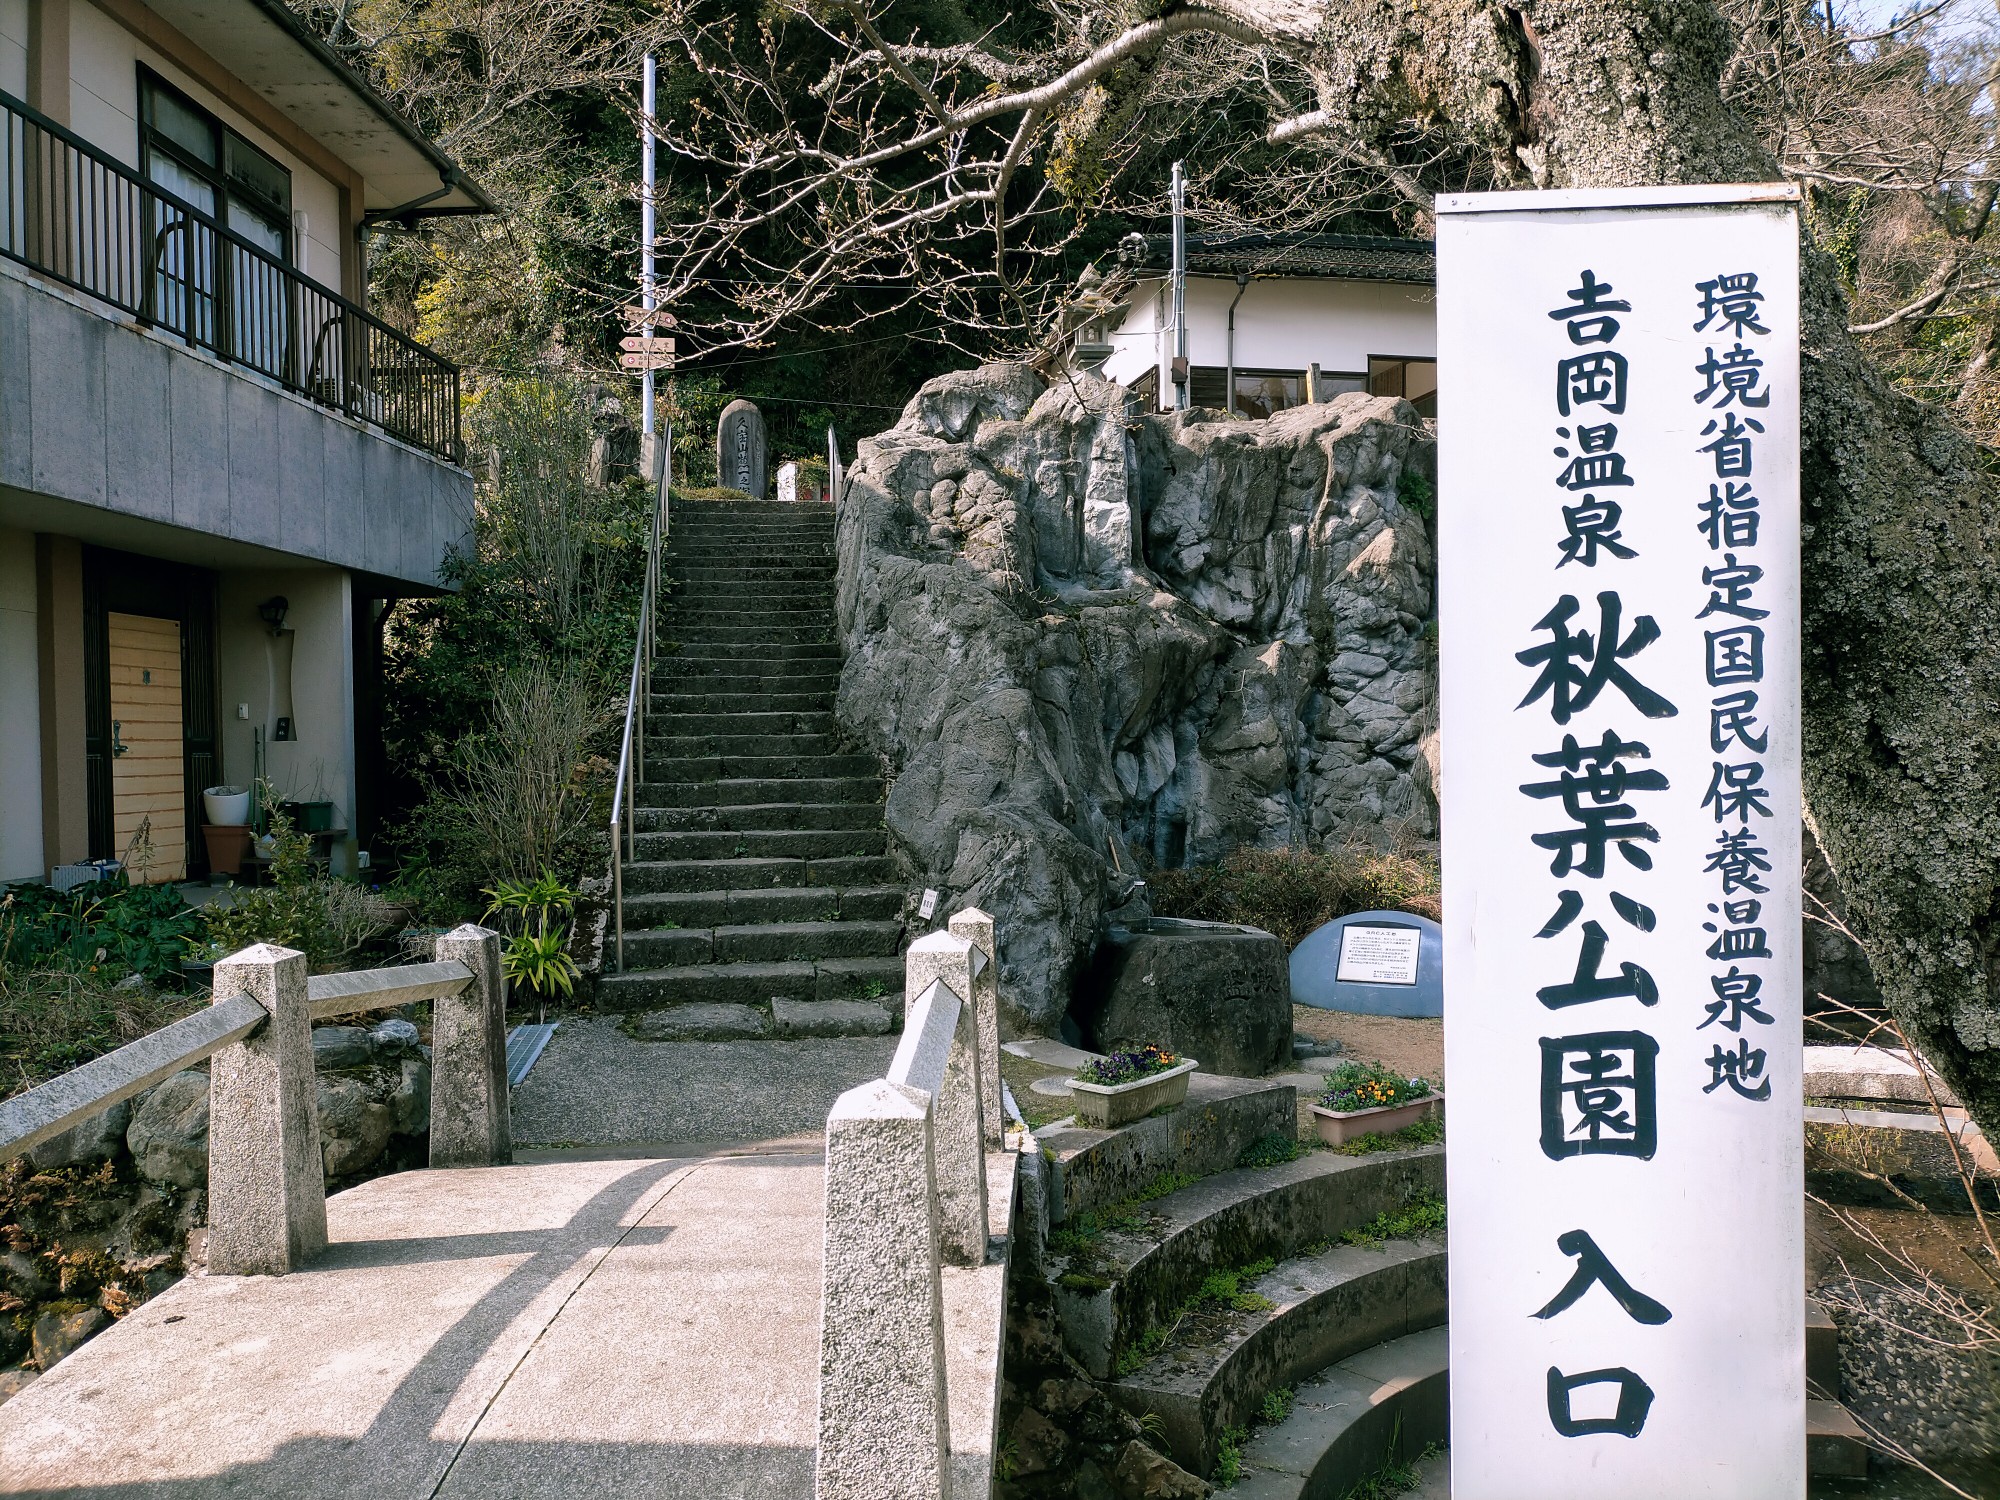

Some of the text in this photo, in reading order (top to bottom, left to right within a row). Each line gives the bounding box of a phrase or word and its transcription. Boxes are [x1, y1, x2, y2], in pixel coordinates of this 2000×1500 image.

[1514, 270, 1679, 1439] 吉岡温泉 秋葉公園 入口
[1692, 272, 1776, 1102] 環境省指定国民保養温泉地
